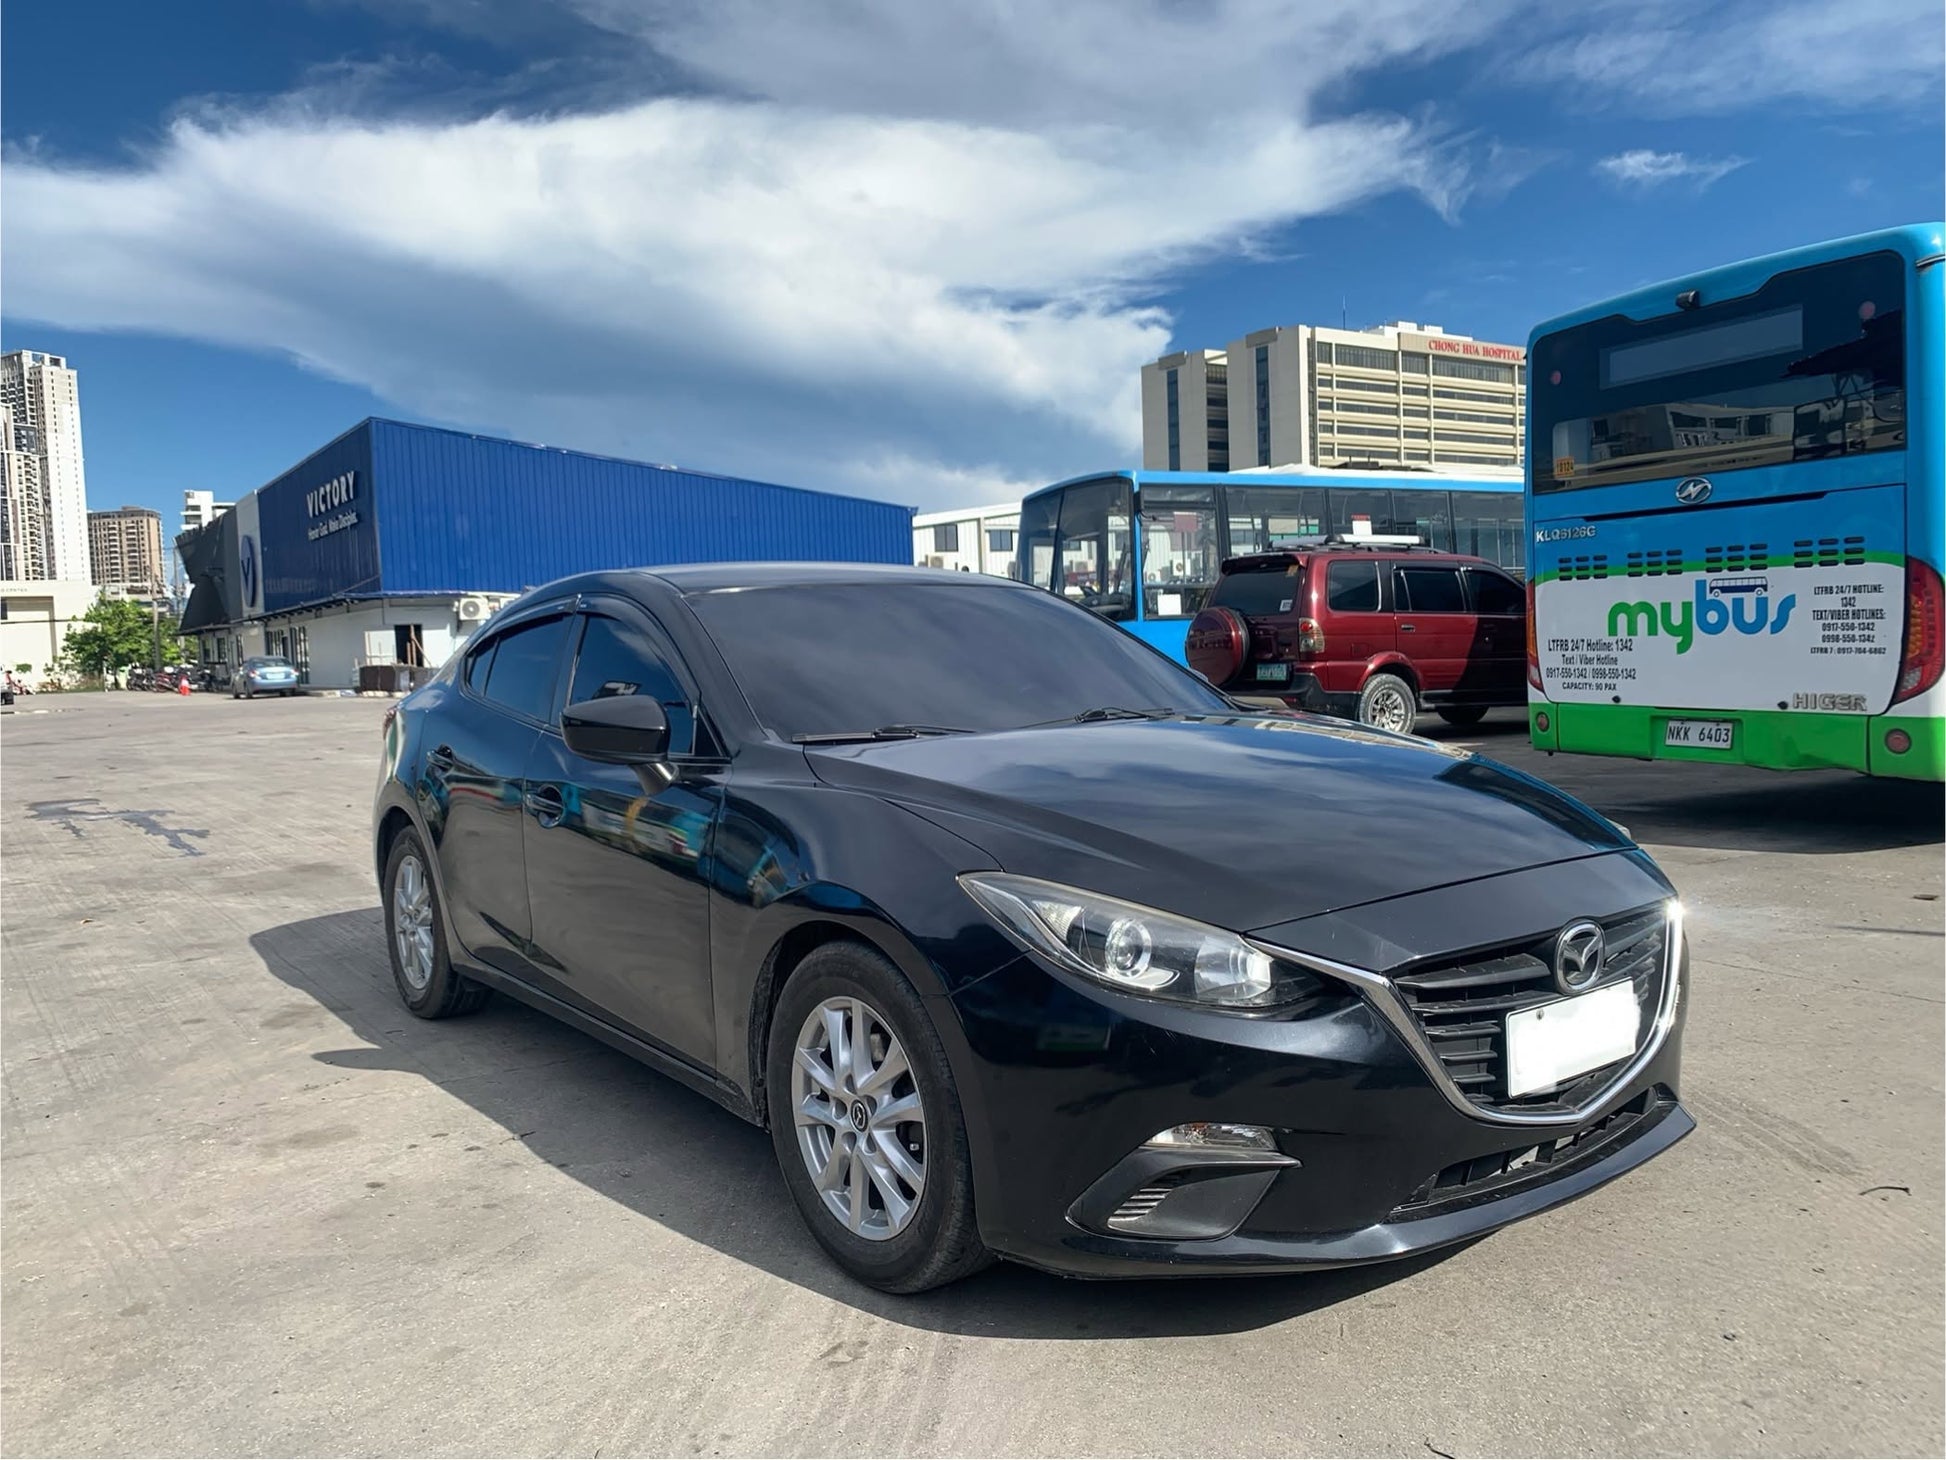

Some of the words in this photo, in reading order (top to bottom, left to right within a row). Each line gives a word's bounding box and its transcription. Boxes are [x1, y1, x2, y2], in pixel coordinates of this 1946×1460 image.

[1428, 340, 1459, 353] CHONG
[1462, 343, 1480, 354] HUA
[1482, 346, 1521, 361] HOSPITAL
[307, 470, 354, 518] VICTORY
[1814, 585, 1834, 595] LTFRB
[1835, 585, 1851, 594] 24/7
[1841, 596, 1856, 607] 1342
[1608, 579, 1796, 655] mybus
[1822, 622, 1875, 631] 0917-550-1342
[1548, 639, 1569, 651] LTFRB
[1570, 639, 1585, 651] 24/7
[1586, 639, 1614, 651] Hotline:
[1615, 639, 1633, 651] 1342
[1562, 654, 1575, 665] Text
[1579, 654, 1595, 665] Viber
[1596, 655, 1618, 665] Hotline
[1546, 667, 1587, 678] 0917-550-1342
[1592, 668, 1636, 679] 0998-550-1342
[1562, 682, 1594, 691] CAPACITY:
[1604, 683, 1617, 691] PAX
[1793, 692, 1868, 711] HIGER
[1667, 725, 1690, 742] NKK
[1699, 726, 1731, 743] 6403
